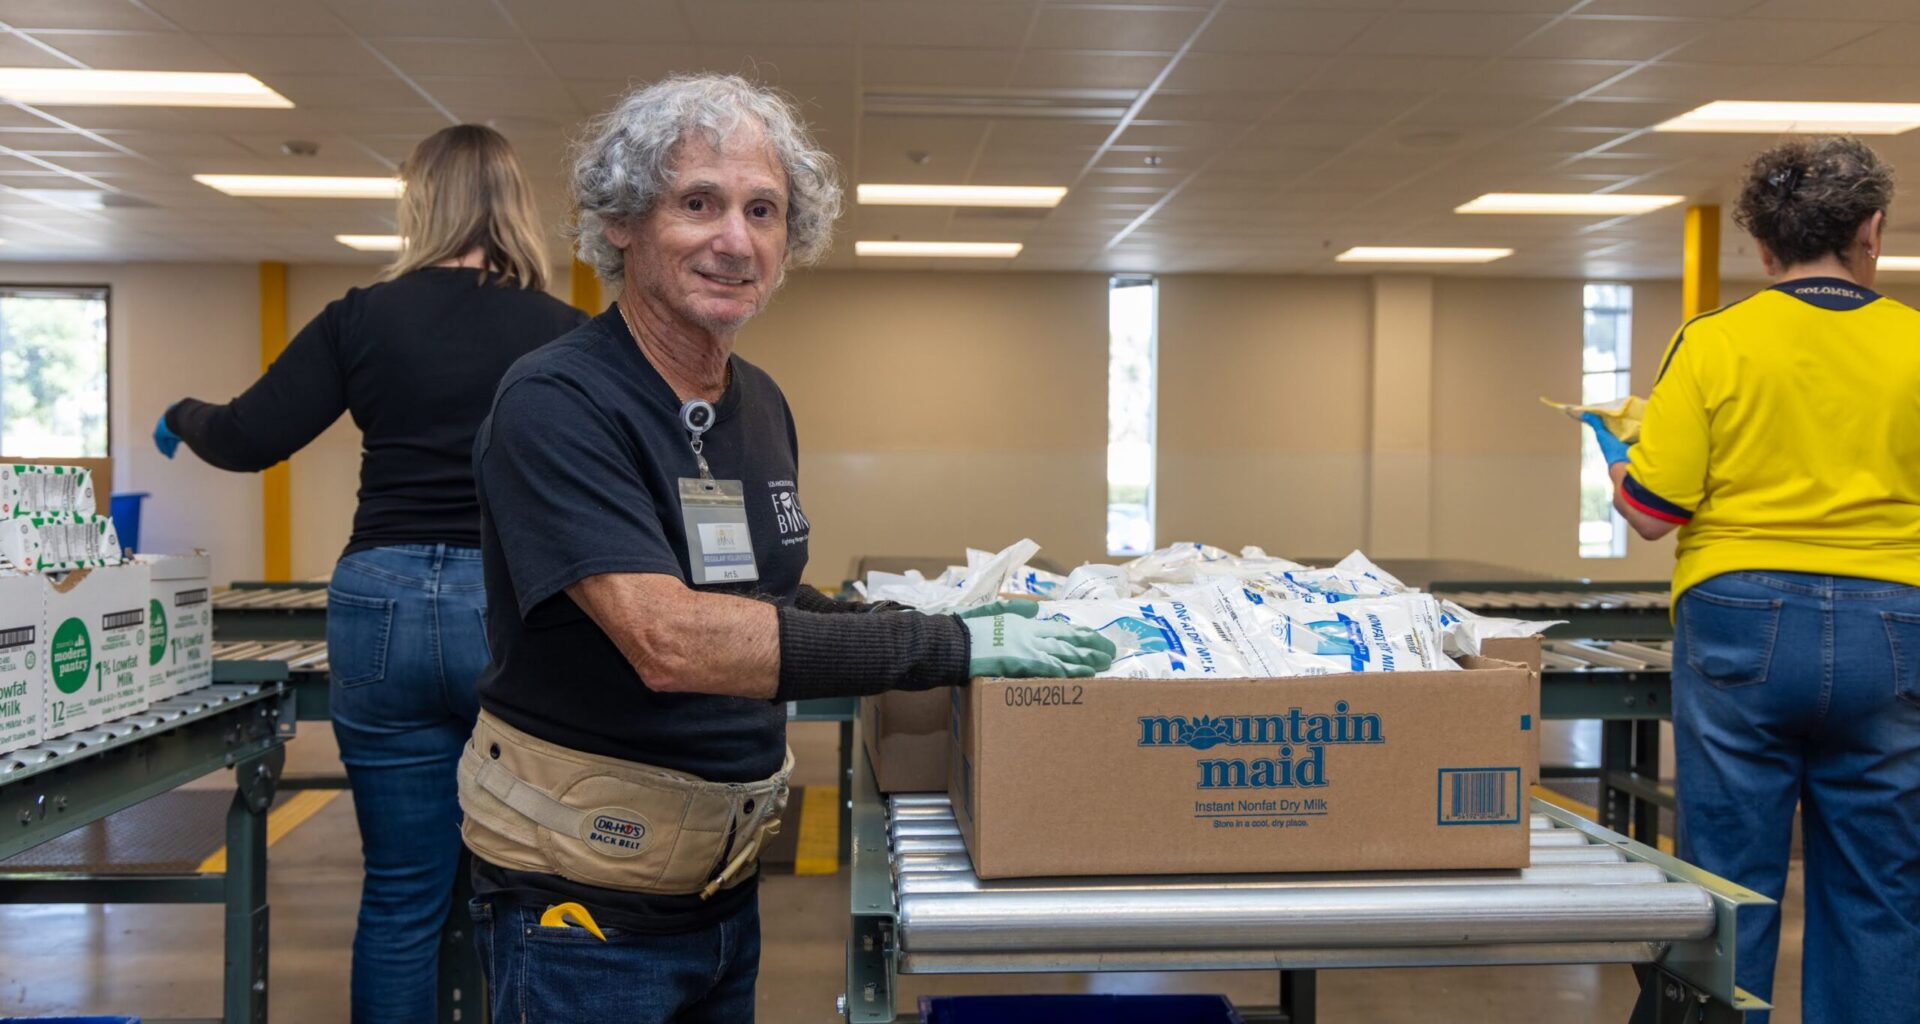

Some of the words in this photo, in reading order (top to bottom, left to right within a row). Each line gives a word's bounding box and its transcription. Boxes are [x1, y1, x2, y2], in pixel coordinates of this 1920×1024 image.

[1795, 286, 1864, 299] COLOMBIA
[55, 648, 87, 662] modern
[113, 655, 138, 672] Lowfat
[1382, 654, 1396, 671] MIL
[59, 659, 88, 677] pantry
[117, 671, 133, 688] Milk
[0, 680, 27, 700] owfat
[1005, 685, 1084, 706] 030426L2
[52, 701, 65, 722] 12
[1197, 744, 1329, 790] maid
[1195, 800, 1235, 812] Instant
[1238, 800, 1277, 812] Nonfat
[1280, 800, 1300, 814] Dry
[1304, 799, 1328, 811] Milk
[1213, 820, 1234, 828] Store
[1235, 820, 1243, 828] in
[1272, 820, 1284, 829] dry
[590, 832, 616, 845] BACK
[618, 840, 641, 850] BELT
